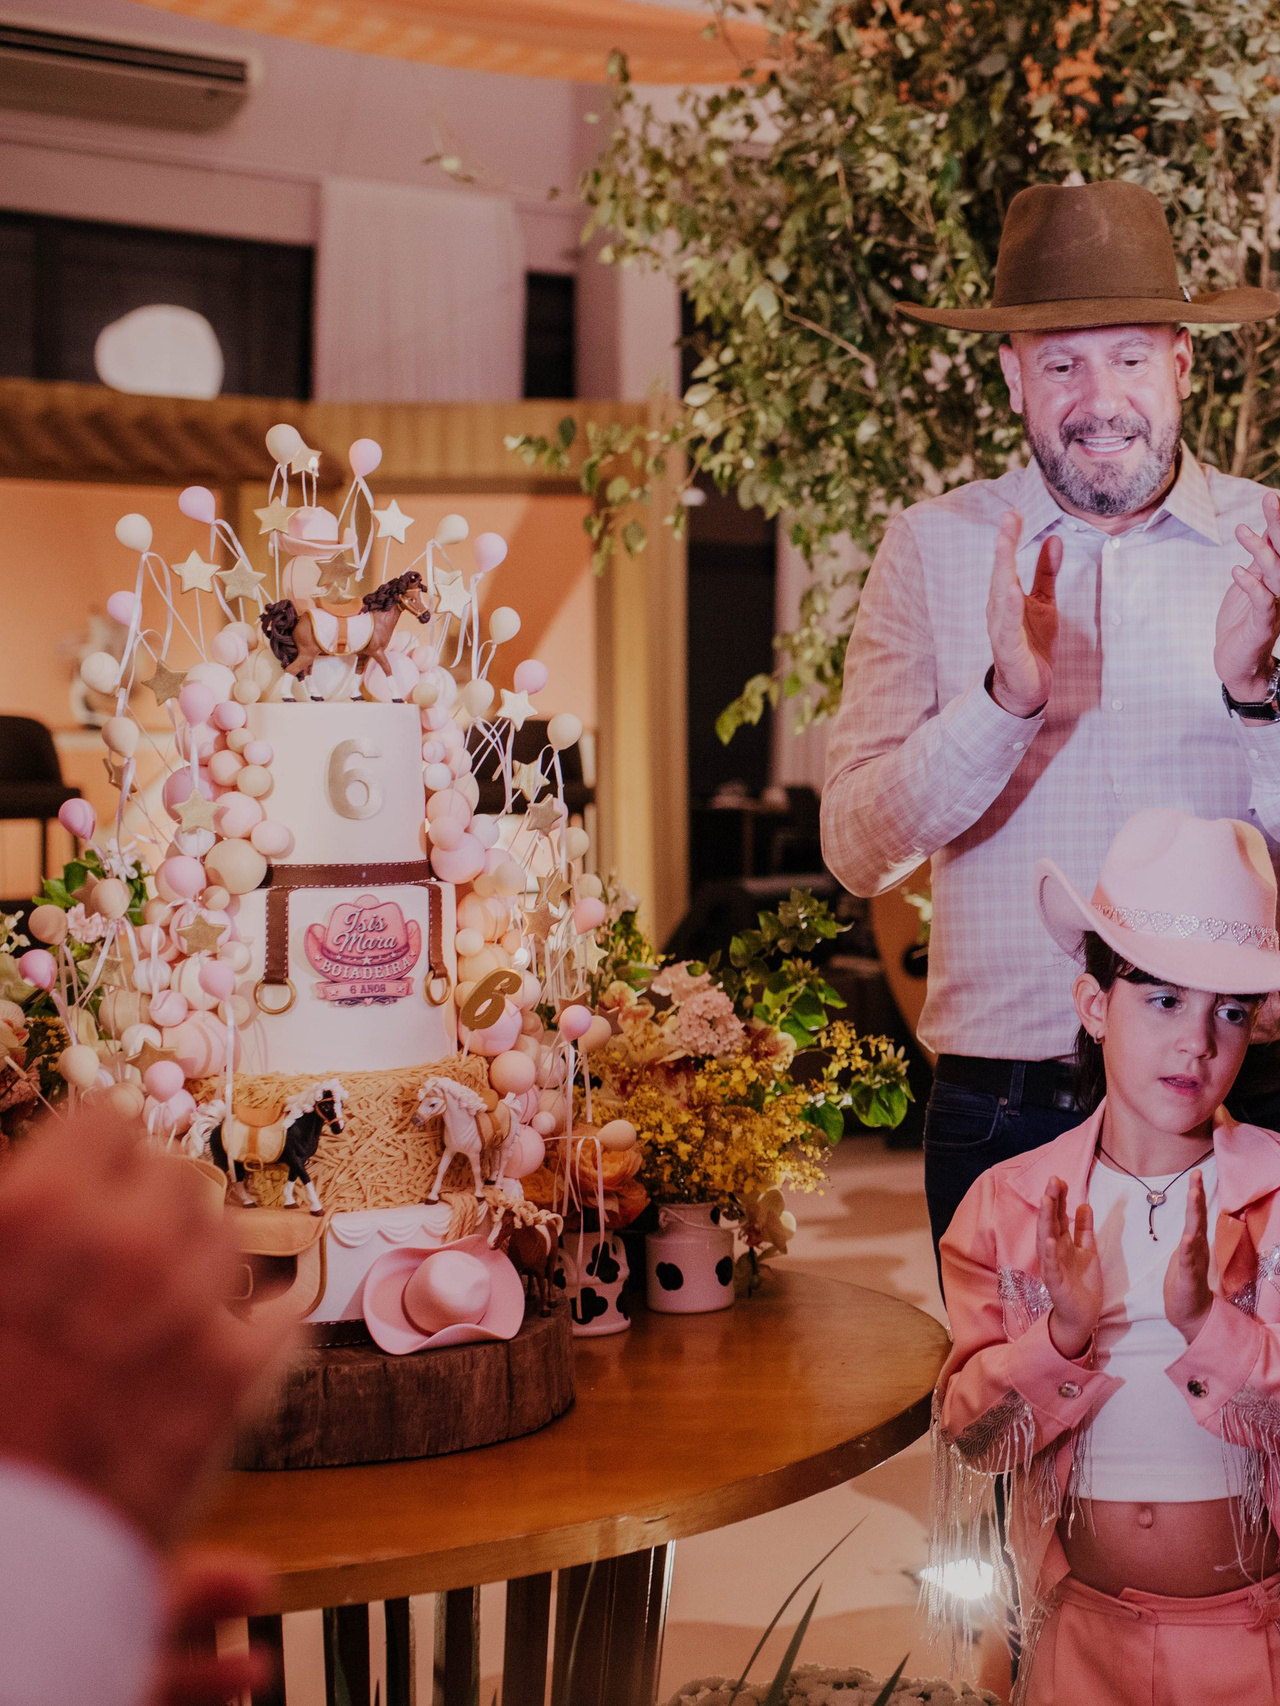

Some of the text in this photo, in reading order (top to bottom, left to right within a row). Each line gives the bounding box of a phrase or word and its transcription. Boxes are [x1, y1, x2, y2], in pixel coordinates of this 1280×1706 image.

[328, 738, 382, 820] 6
[333, 932, 398, 954] Mara
[321, 957, 411, 980] BOIADEIRA
[350, 984, 386, 994] 6 ANOS
[460, 967, 522, 1030] 6
